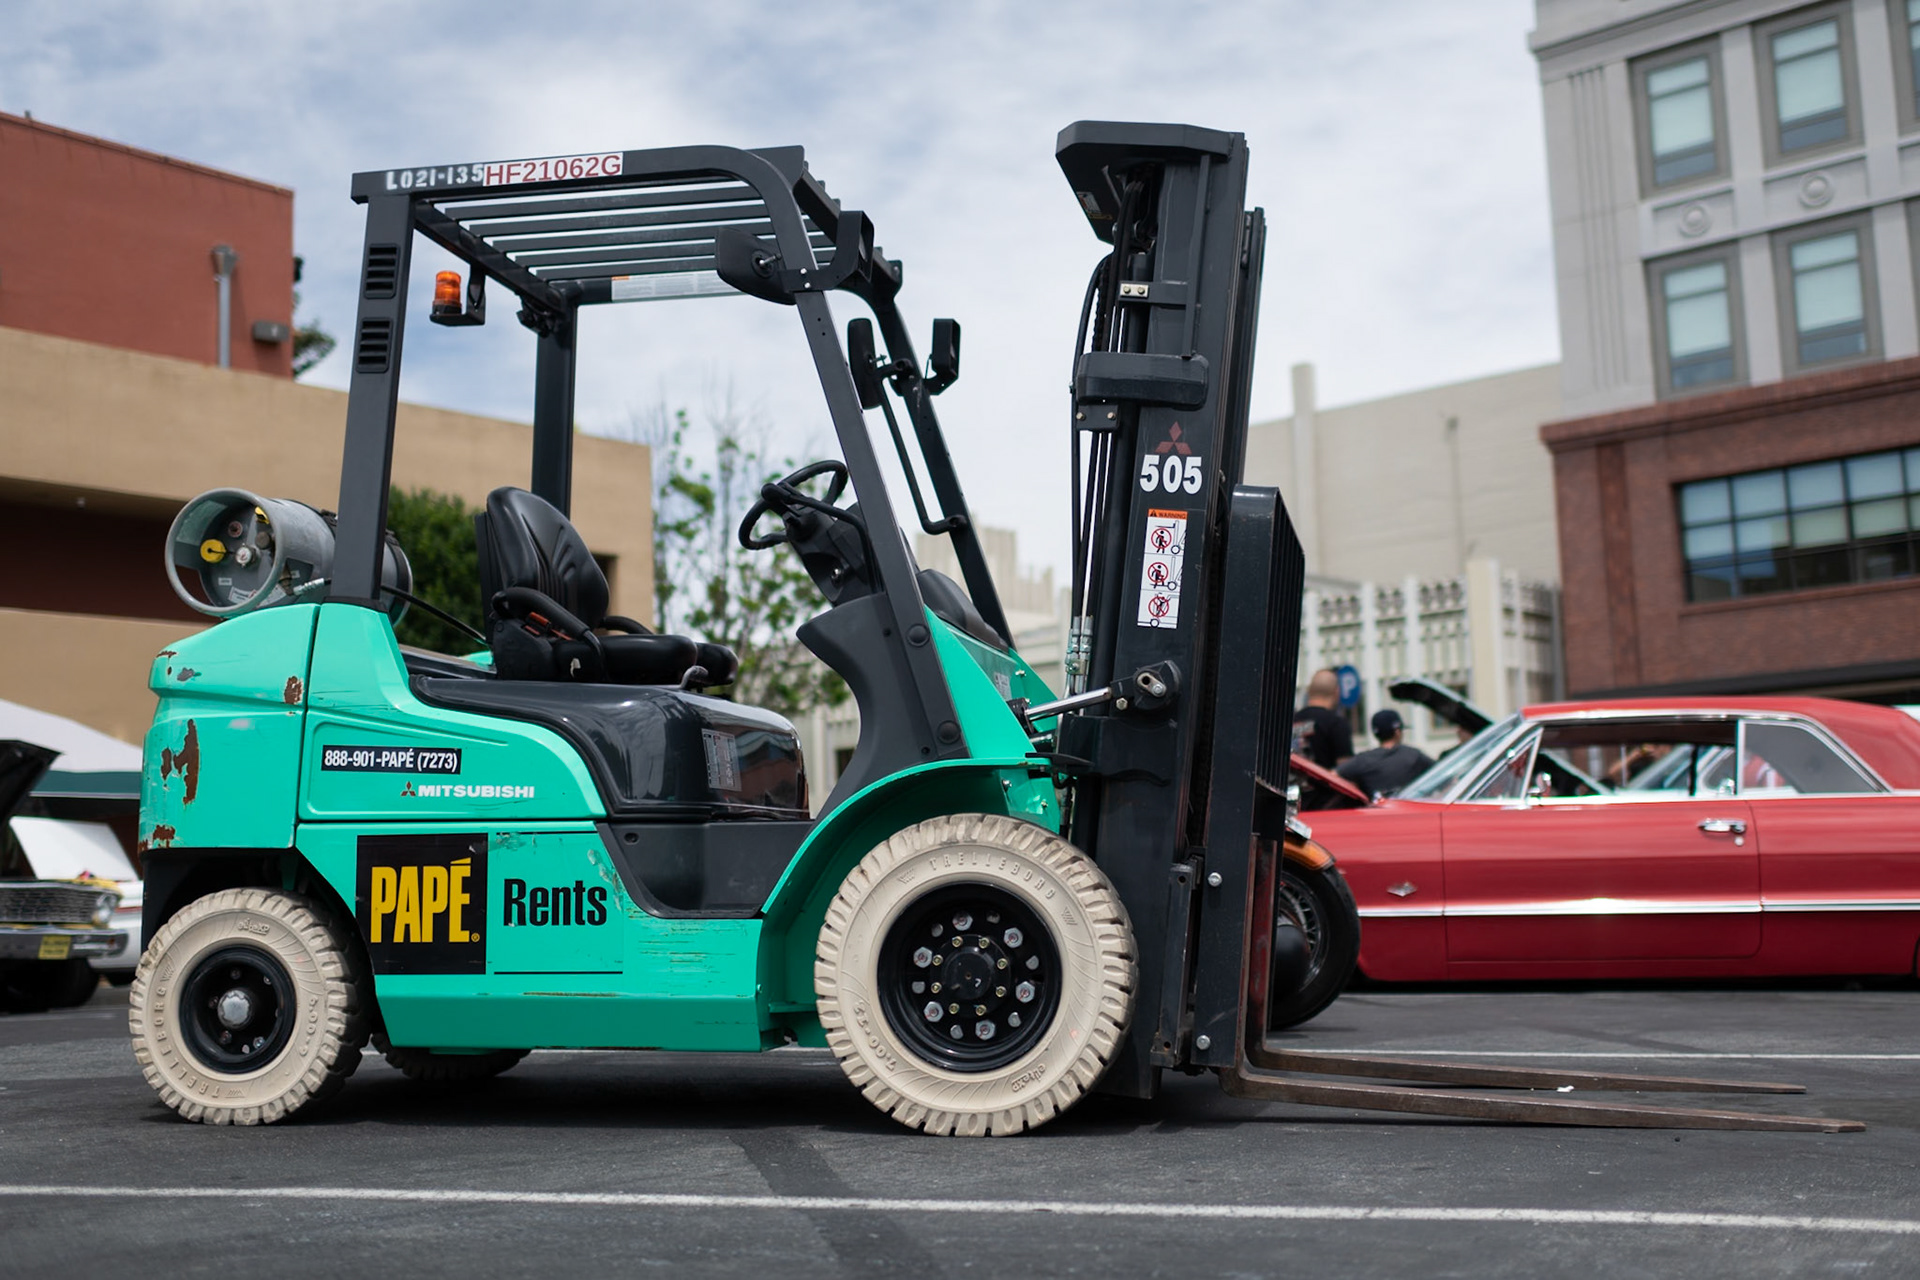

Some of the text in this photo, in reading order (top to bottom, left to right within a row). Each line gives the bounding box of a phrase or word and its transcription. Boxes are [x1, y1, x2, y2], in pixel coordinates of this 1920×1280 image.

[485, 155, 622, 185] HF21062G
[1140, 454, 1203, 494] 505
[324, 749, 458, 772] 888-901-PAPÉ (7273)
[418, 785, 535, 798] MITSUBISHI
[928, 851, 1056, 899] TRELLEBORG
[370, 857, 472, 943] PAPÉ
[503, 878, 607, 926] Rents
[154, 987, 220, 1099] TRELLEBORG
